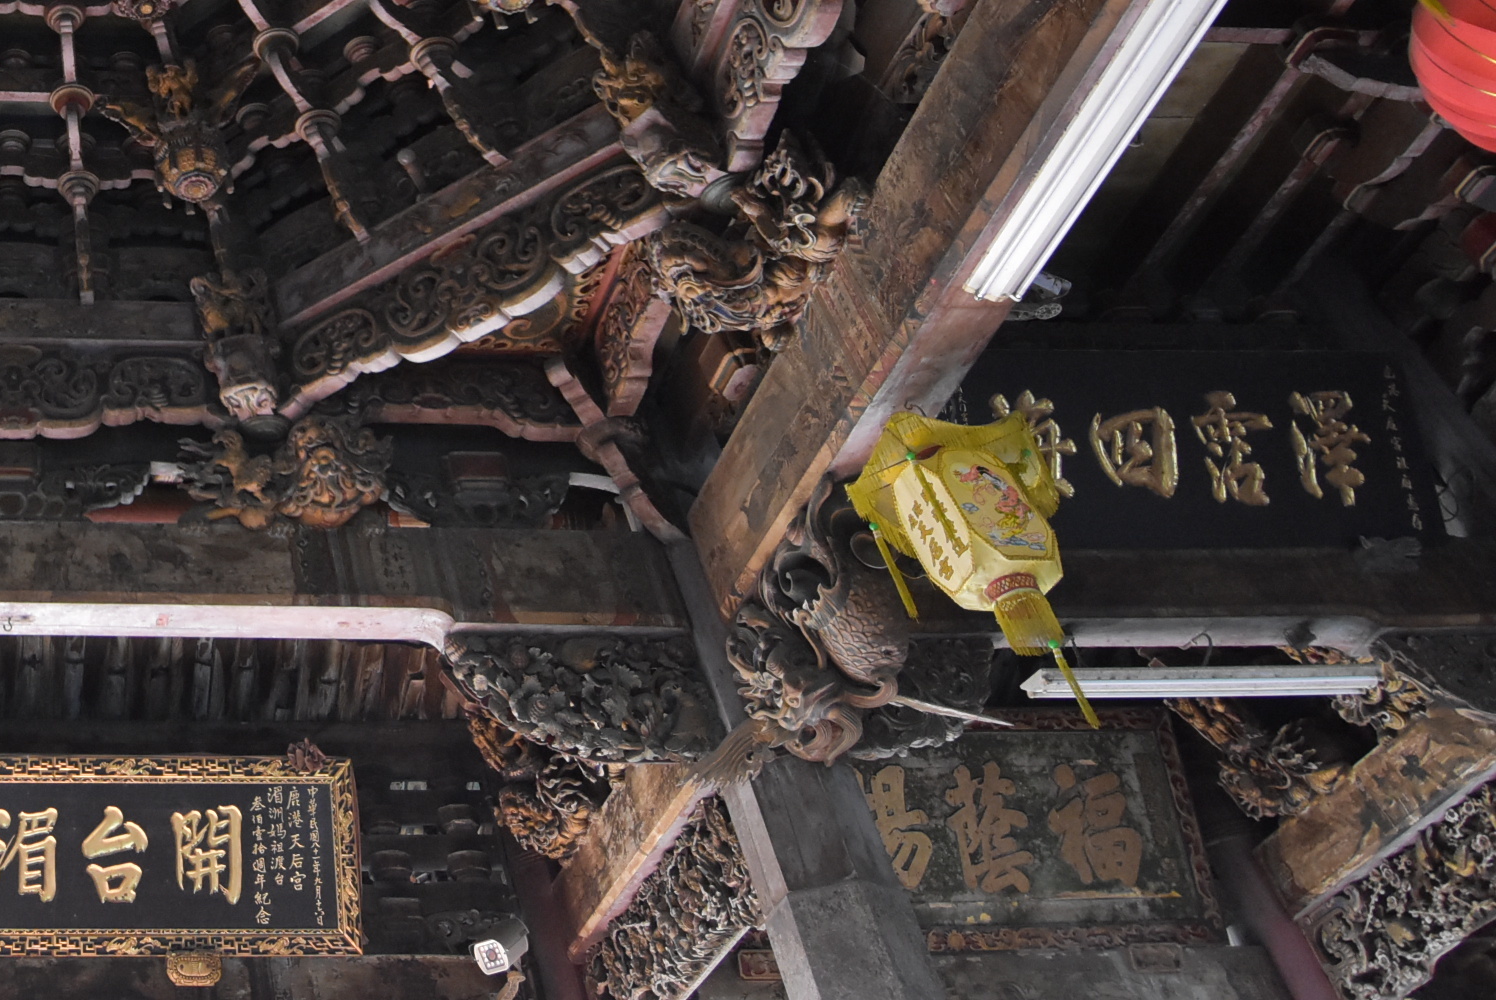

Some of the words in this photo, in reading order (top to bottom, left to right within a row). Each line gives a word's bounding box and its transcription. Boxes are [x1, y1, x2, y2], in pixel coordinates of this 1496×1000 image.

[267, 785, 286, 886] 湄洲媽祖渡台
[286, 786, 307, 892] 鹿港天后宮
